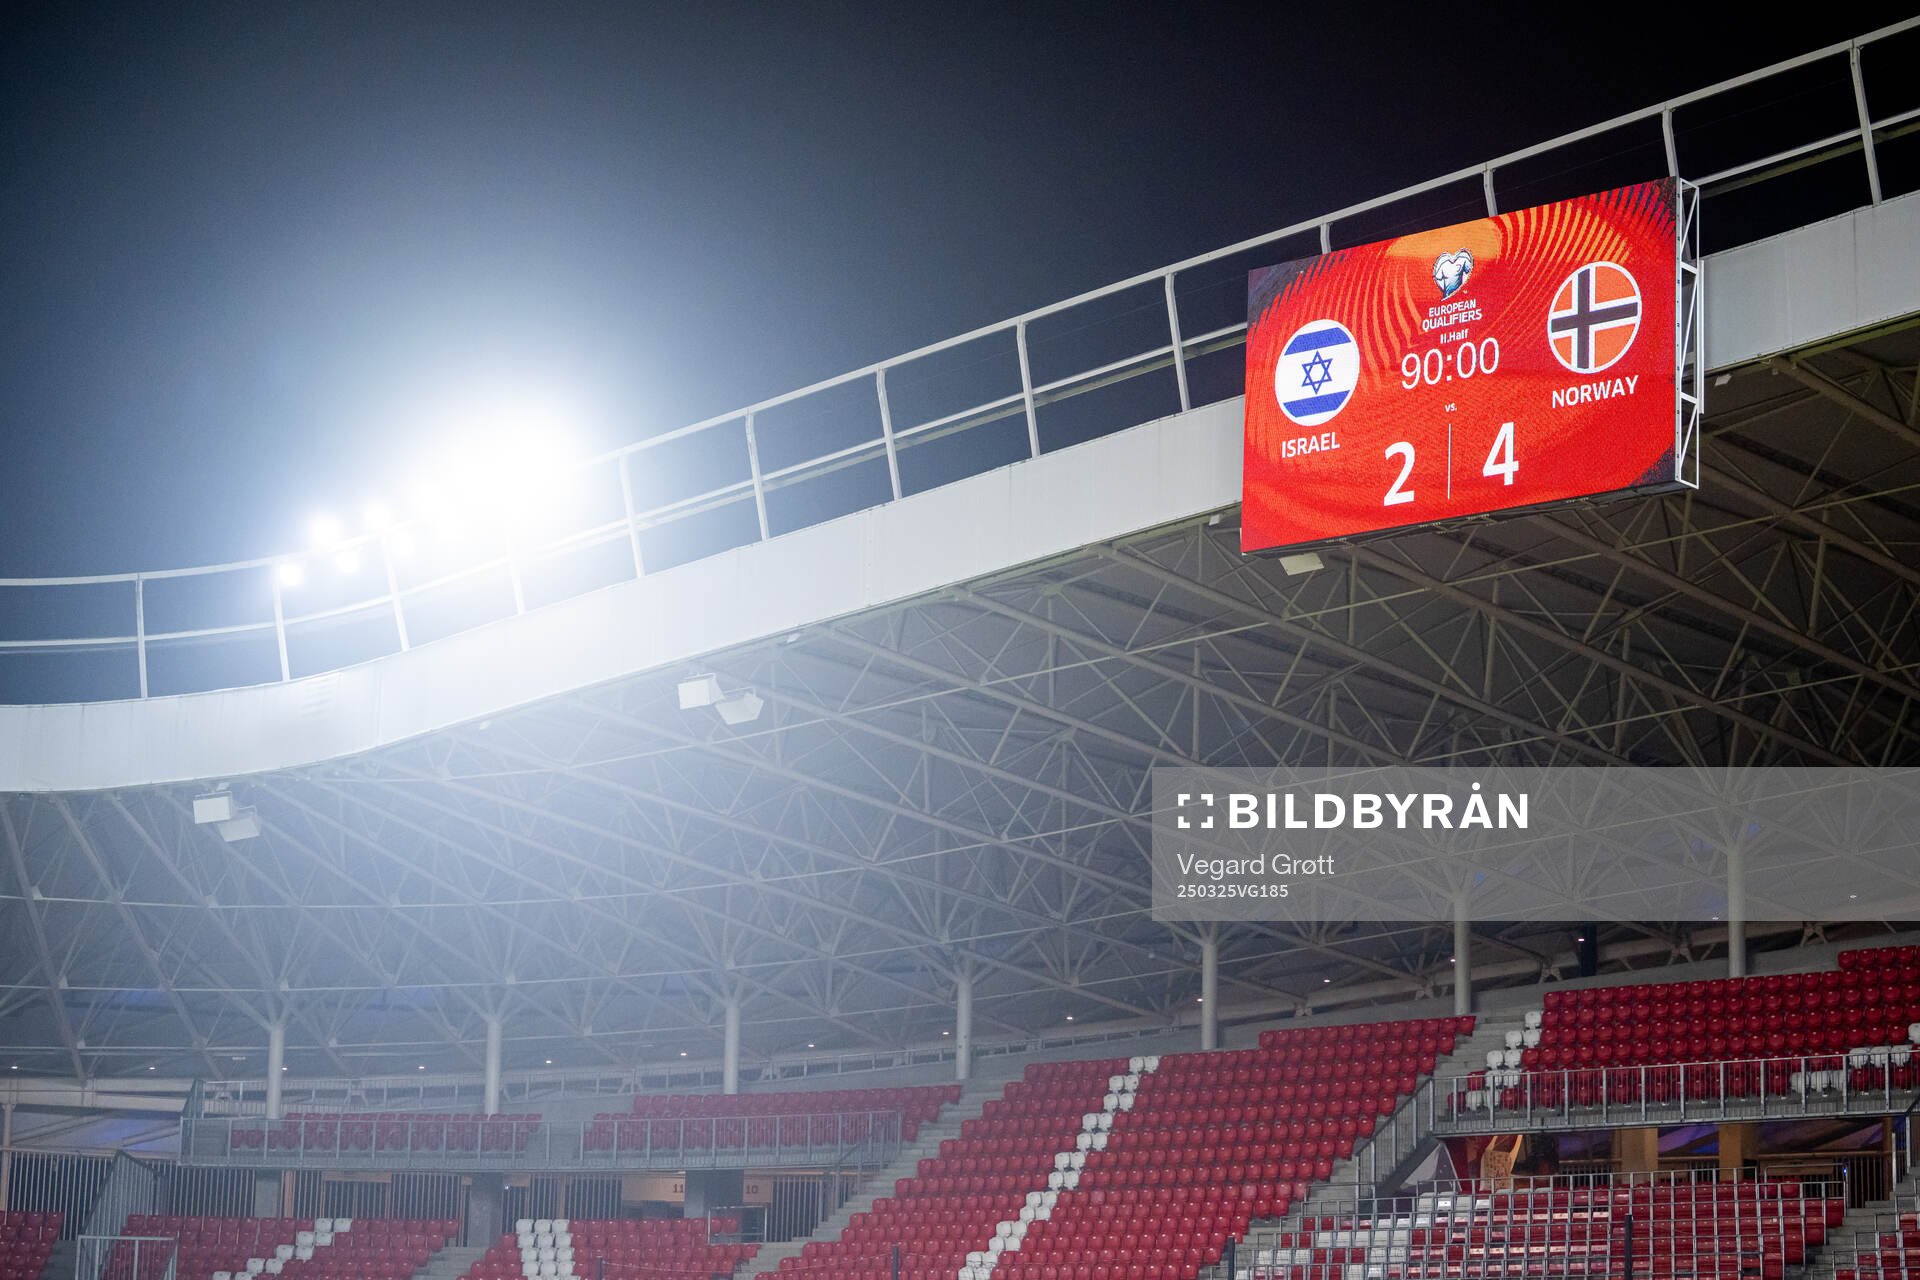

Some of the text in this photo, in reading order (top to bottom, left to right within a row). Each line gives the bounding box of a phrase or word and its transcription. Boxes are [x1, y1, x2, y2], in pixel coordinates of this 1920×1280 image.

[1422, 309, 1483, 332] QUALIFIERS
[1428, 299, 1477, 318] EUROPEAN
[1401, 337, 1500, 390] 90:00
[1551, 375, 1640, 409] NORWAY
[1281, 432, 1340, 459] ISRAEL
[1482, 421, 1519, 486] 4
[1383, 441, 1416, 506] 2
[745, 1185, 758, 1194] 10
